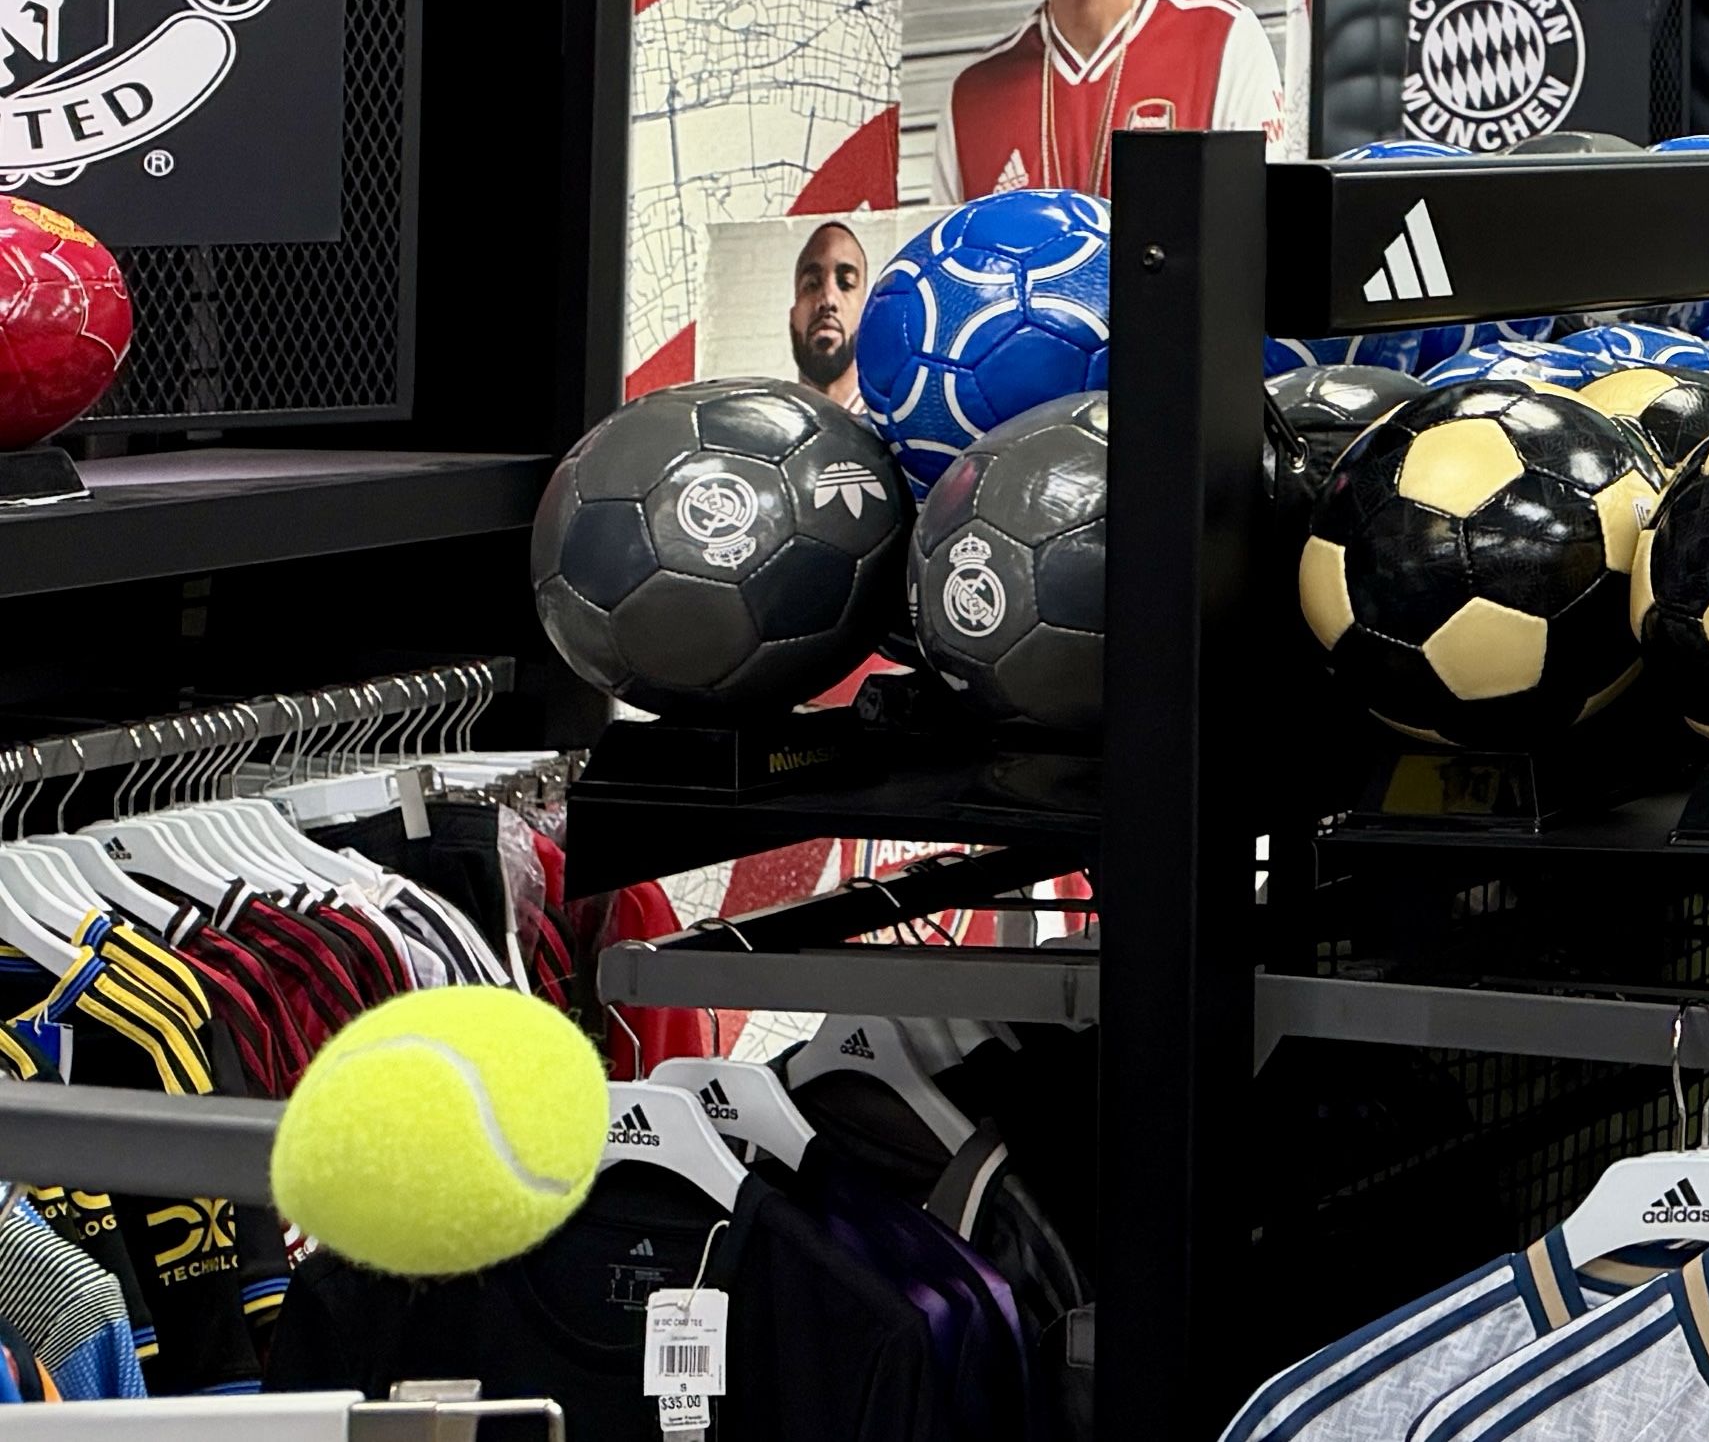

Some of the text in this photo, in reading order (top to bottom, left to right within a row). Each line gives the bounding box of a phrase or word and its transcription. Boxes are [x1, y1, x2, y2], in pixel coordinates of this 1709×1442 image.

[839, 1044, 875, 1061] adidas
[606, 1128, 661, 1147] adidas
[660, 1395, 701, 1411] $35.00
